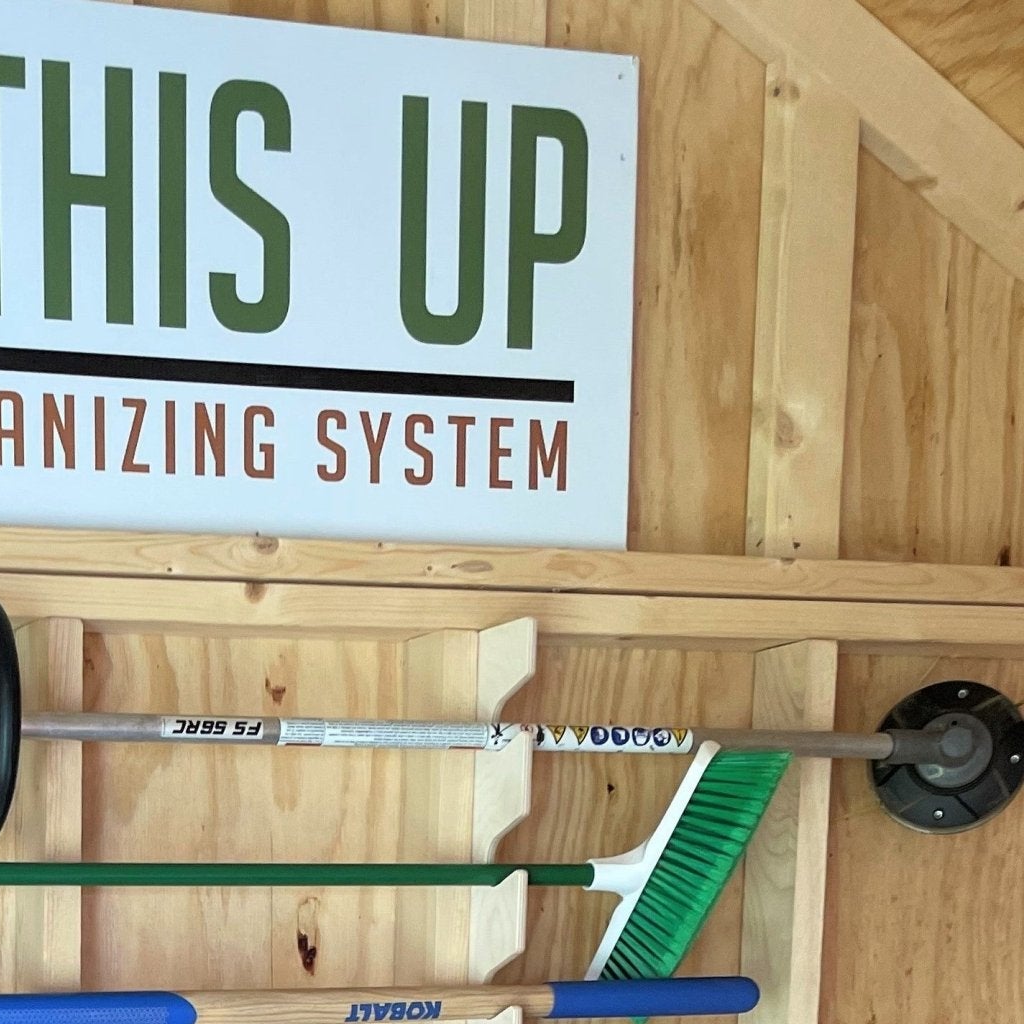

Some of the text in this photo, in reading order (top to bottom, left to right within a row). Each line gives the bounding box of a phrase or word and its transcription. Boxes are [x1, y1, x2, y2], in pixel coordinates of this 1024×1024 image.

[399, 95, 589, 351] UP
[316, 409, 569, 493] SYSTEM
[172, 719, 228, 736] 56RC
[233, 721, 263, 736] FS
[344, 1001, 442, 1023] KOBALT
